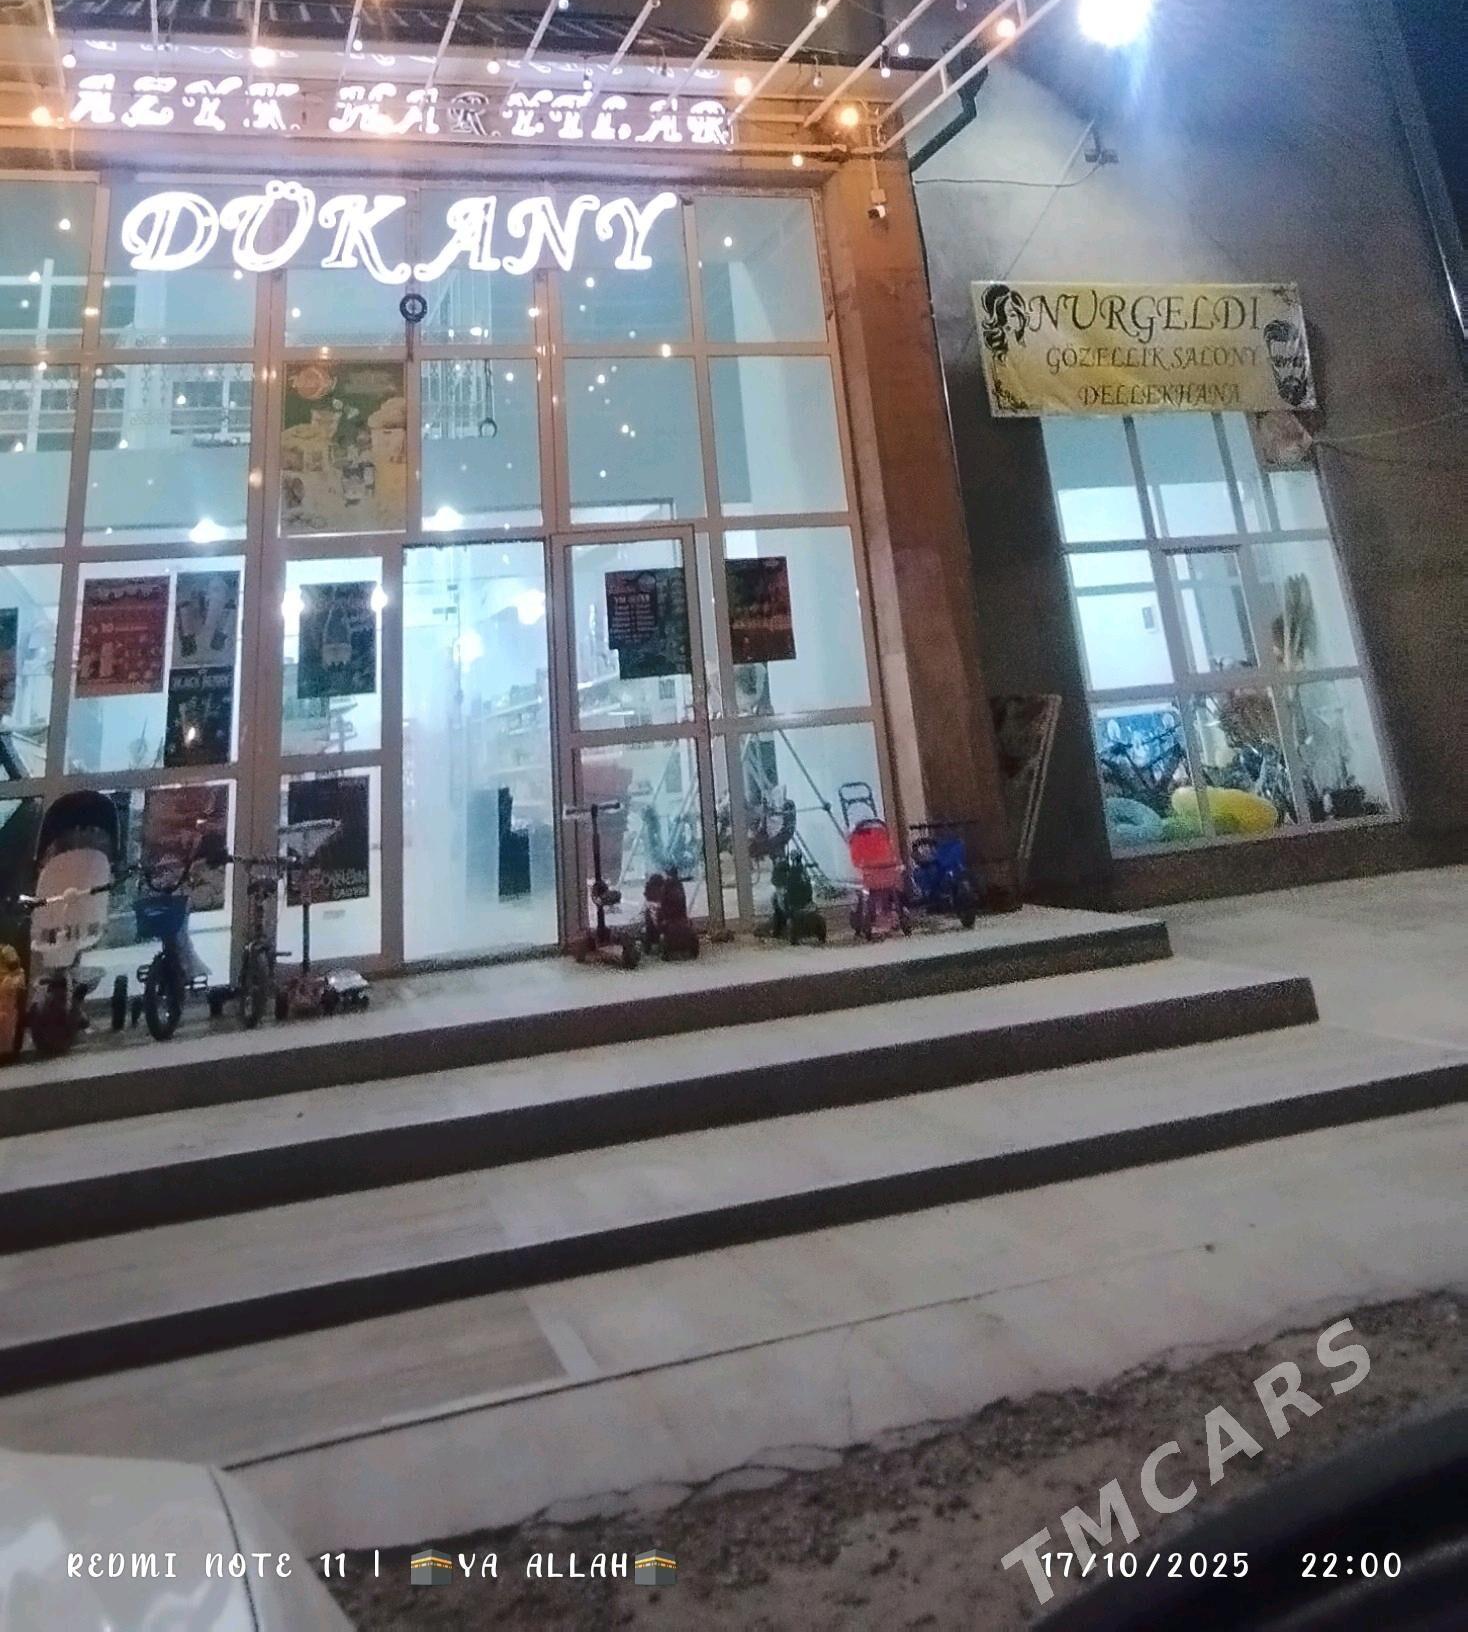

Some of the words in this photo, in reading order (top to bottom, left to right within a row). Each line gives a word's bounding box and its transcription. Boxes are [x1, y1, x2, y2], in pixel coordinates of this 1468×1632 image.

[121, 180, 678, 283] DÜKANY
[1028, 289, 1261, 344] NURGELDI
[1170, 345, 1261, 370] SALONY
